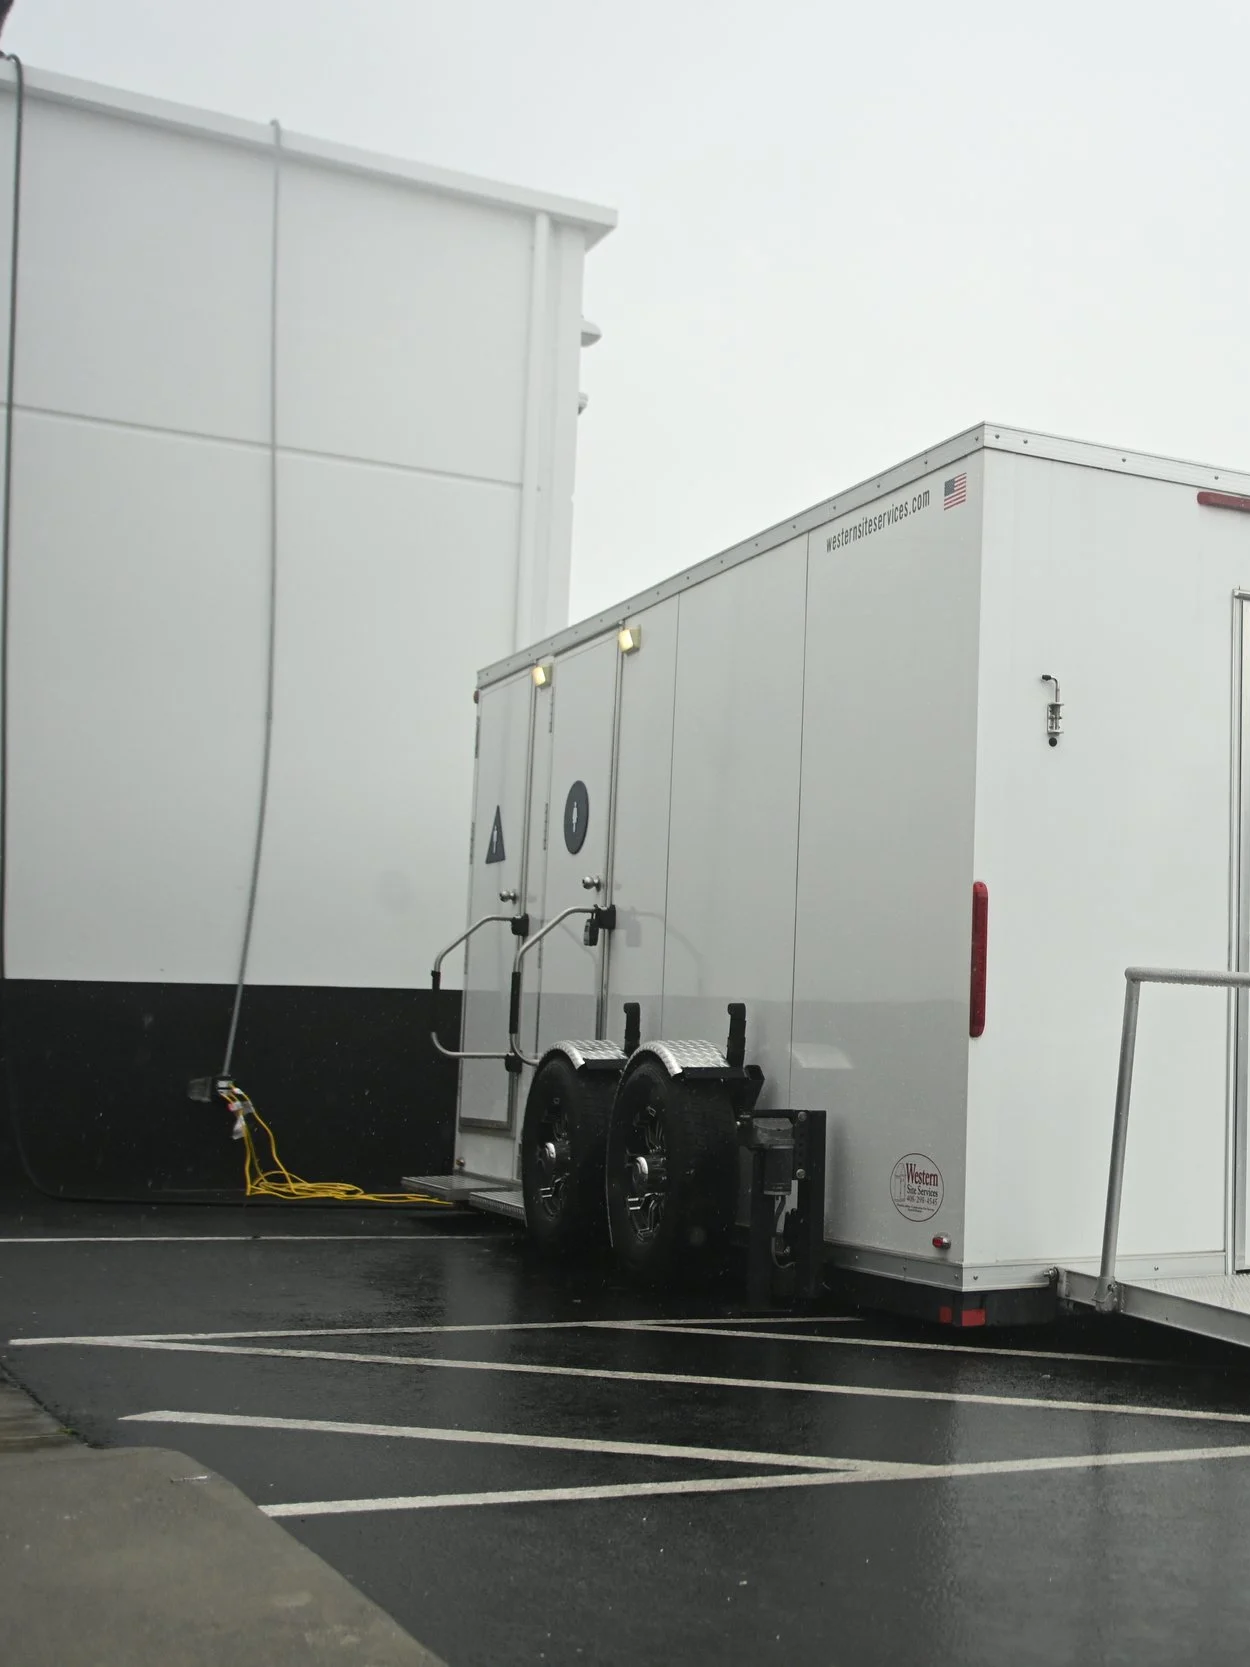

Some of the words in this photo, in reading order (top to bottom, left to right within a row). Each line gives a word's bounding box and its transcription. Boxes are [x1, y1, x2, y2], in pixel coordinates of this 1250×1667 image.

[826, 489, 930, 553] westernsiteservices.com
[906, 1163, 938, 1186] Western
[906, 1184, 917, 1195] Site
[917, 1186, 938, 1197] Services
